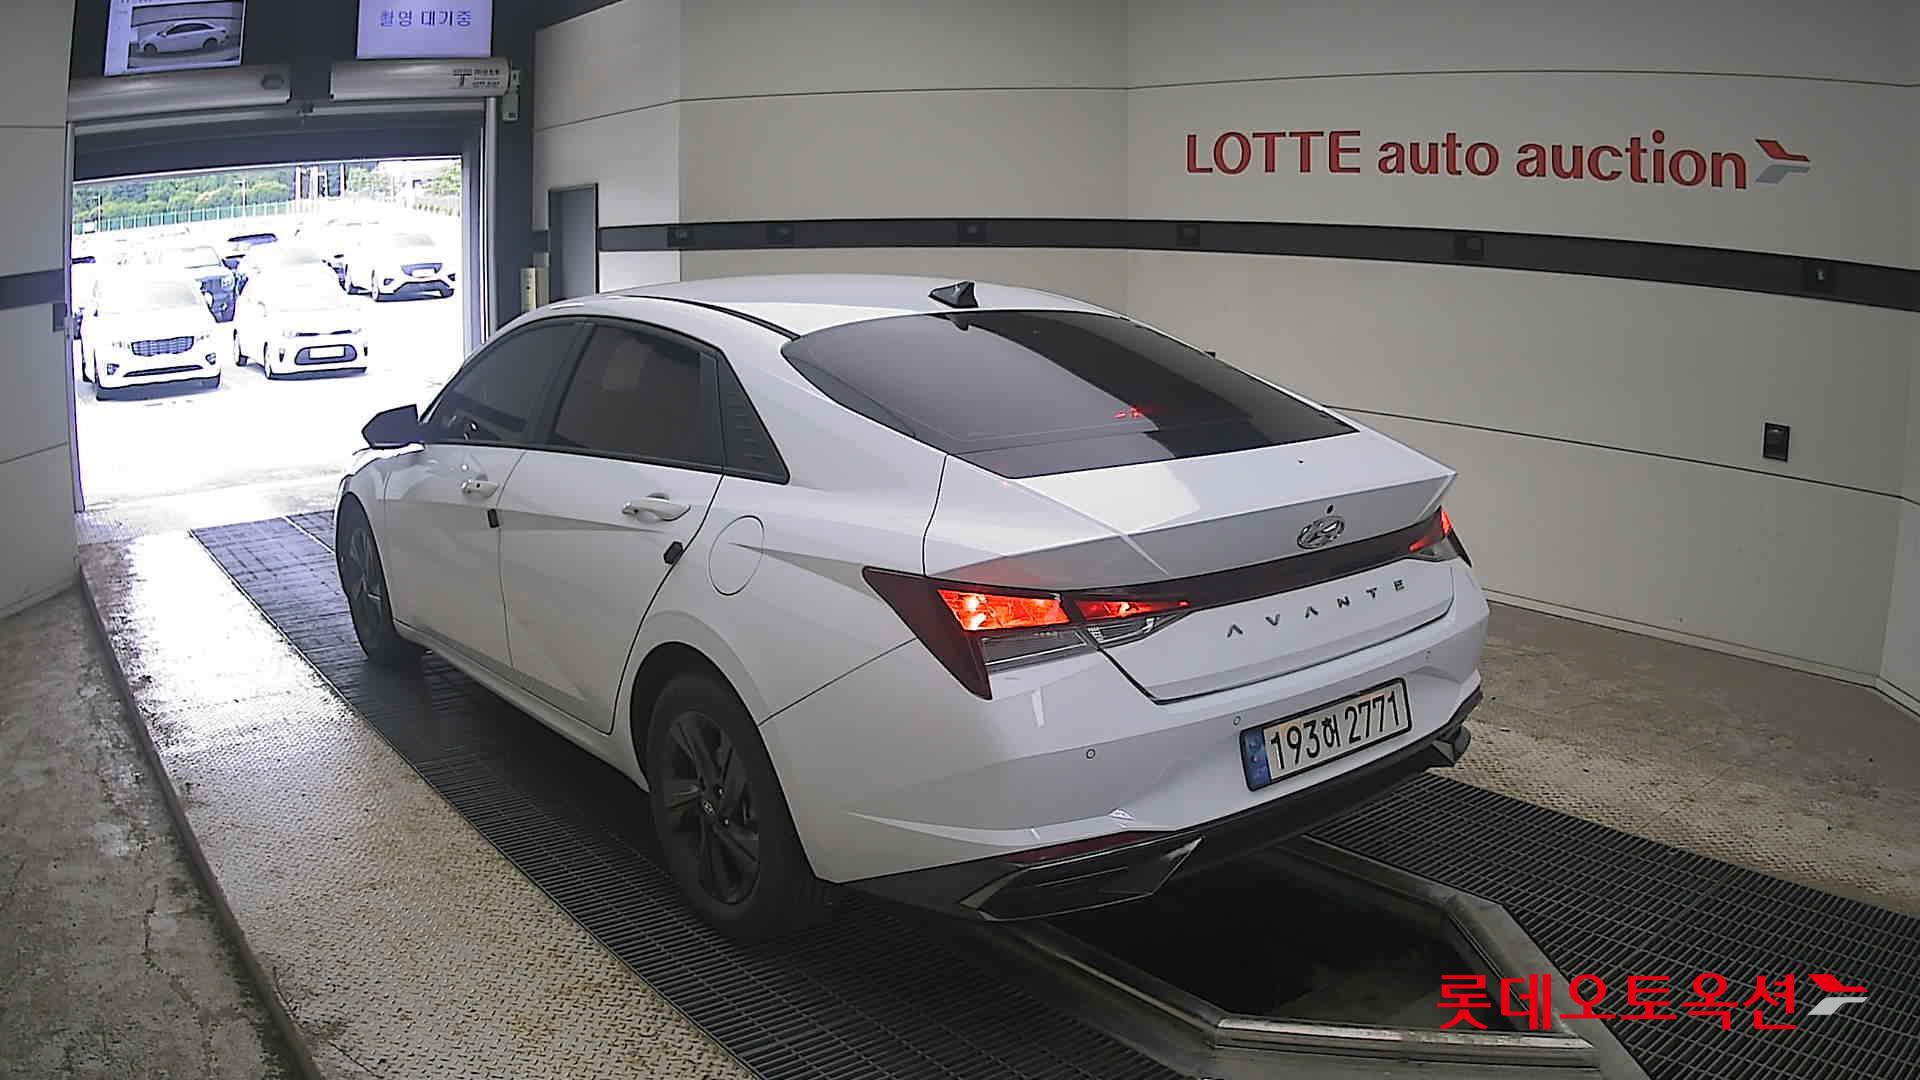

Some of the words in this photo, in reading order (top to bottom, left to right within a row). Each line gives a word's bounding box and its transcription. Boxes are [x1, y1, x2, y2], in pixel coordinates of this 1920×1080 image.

[421, 10, 472, 27] 대기중
[1186, 130, 1361, 174] LOTTE
[1377, 132, 1499, 176] auto
[1516, 130, 1747, 189] auction
[1226, 579, 1405, 637] AVANTE
[1344, 690, 1399, 744] 2771
